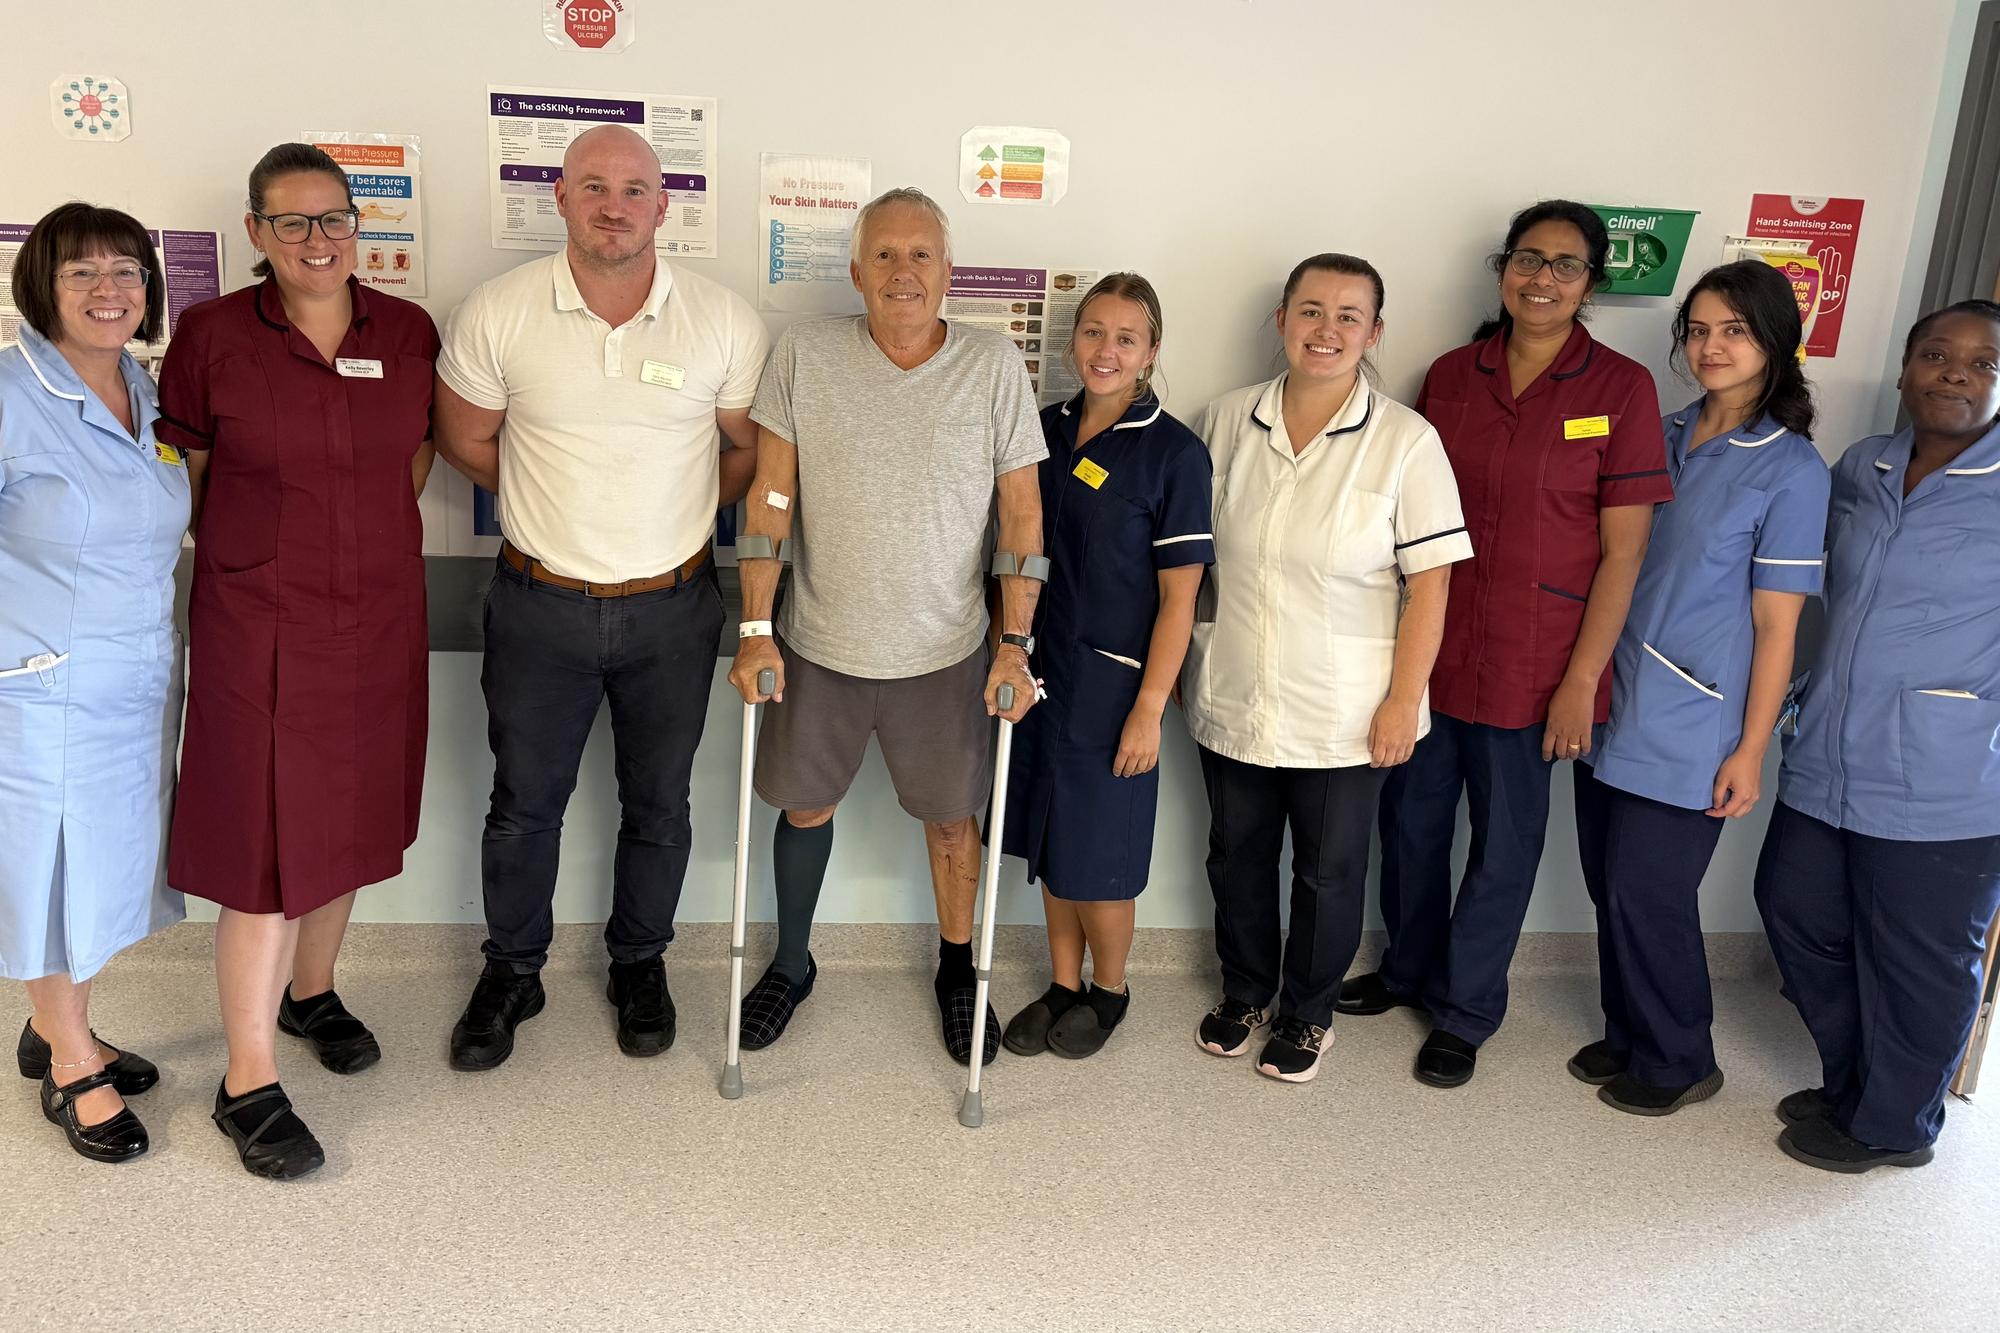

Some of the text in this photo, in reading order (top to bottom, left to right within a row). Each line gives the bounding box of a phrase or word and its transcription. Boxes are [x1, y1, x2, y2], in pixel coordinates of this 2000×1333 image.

[568, 8, 612, 22] STOP
[518, 102, 533, 110] The
[535, 103, 574, 114] aSSKINg
[576, 106, 625, 116] Framework
[318, 146, 399, 158] TOP the Pressure
[542, 170, 548, 178] S
[357, 176, 376, 185] bed
[379, 178, 405, 186] sores
[783, 177, 844, 190] No Pressure
[350, 186, 403, 196] reventable
[769, 195, 858, 209] Your Skin Matters
[1608, 215, 1656, 230] clinell
[1756, 218, 1852, 230] Hand Sanitising Zone
[1792, 281, 1810, 290] EAN
[1794, 292, 1808, 300] UR
[1822, 290, 1840, 301] OP
